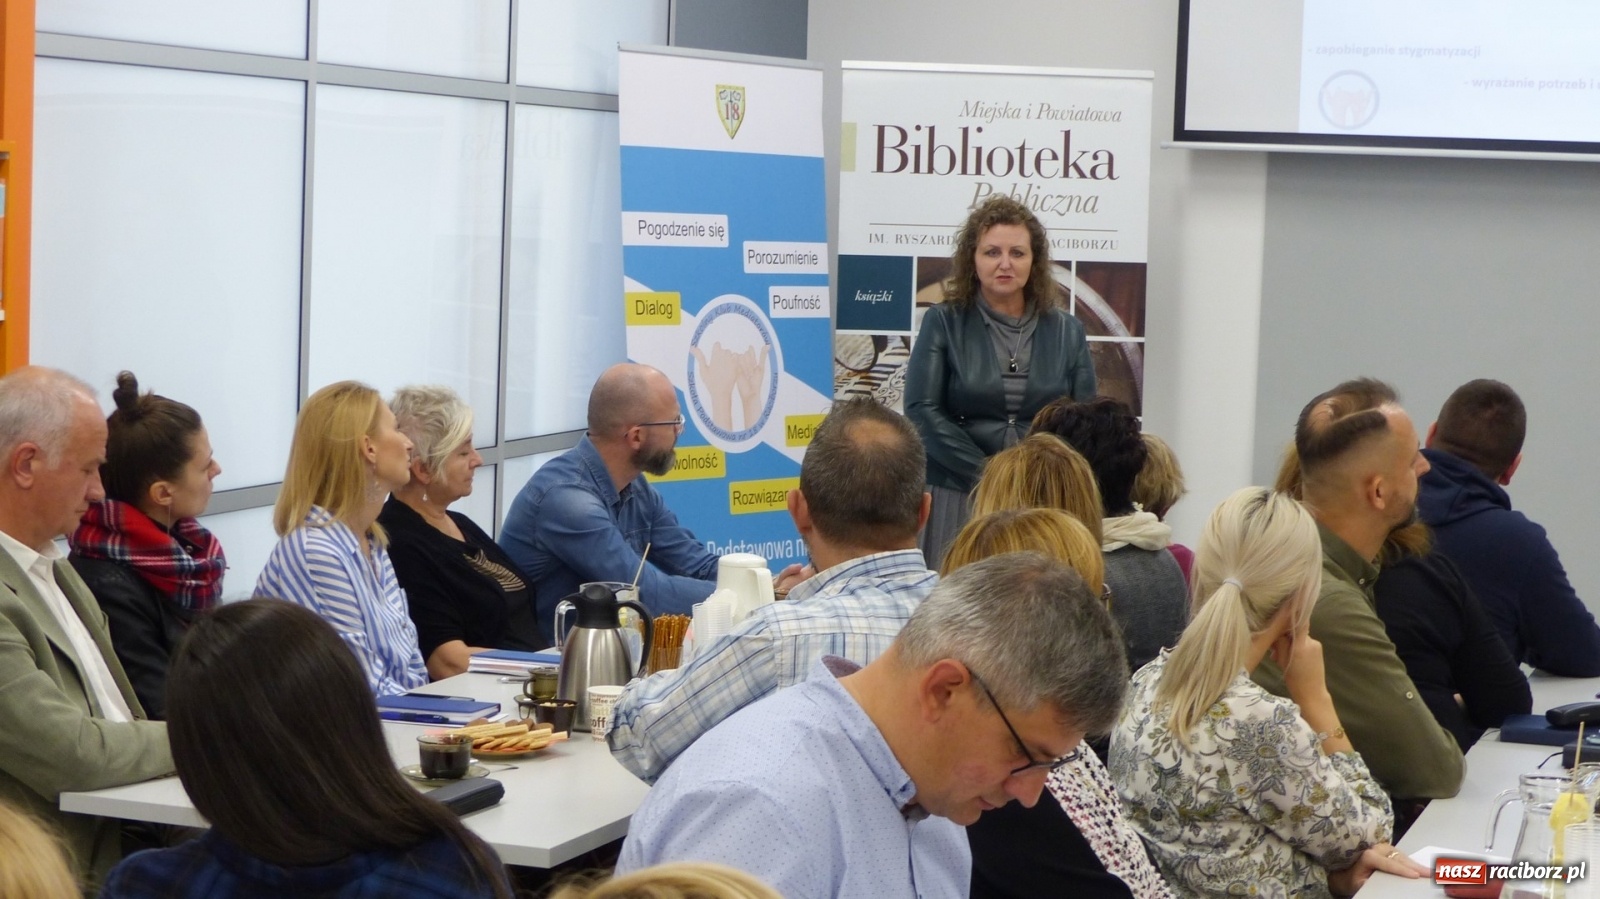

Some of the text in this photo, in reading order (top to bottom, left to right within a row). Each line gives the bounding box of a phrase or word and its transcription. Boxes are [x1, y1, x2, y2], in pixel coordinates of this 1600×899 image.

[1315, 44, 1395, 58] zapobieganie
[1398, 45, 1482, 59] stygmatyzacji
[1538, 77, 1587, 92] potrzeb
[724, 102, 740, 121] 18
[958, 100, 1122, 123] Miejska i Powiatowa
[871, 124, 1120, 180] Biblioteka
[967, 181, 1100, 217] Pbliczna
[638, 219, 725, 241] Pogodzenie się
[869, 233, 1119, 251] IM. RYSZARD ACIBORZU
[747, 249, 818, 267] Porozumienie
[773, 294, 821, 311] Poufność
[855, 289, 893, 304] książki
[635, 299, 673, 319] Dialog
[715, 303, 732, 317] Klub
[697, 406, 736, 441] Podstawowa
[674, 452, 719, 470] wolność
